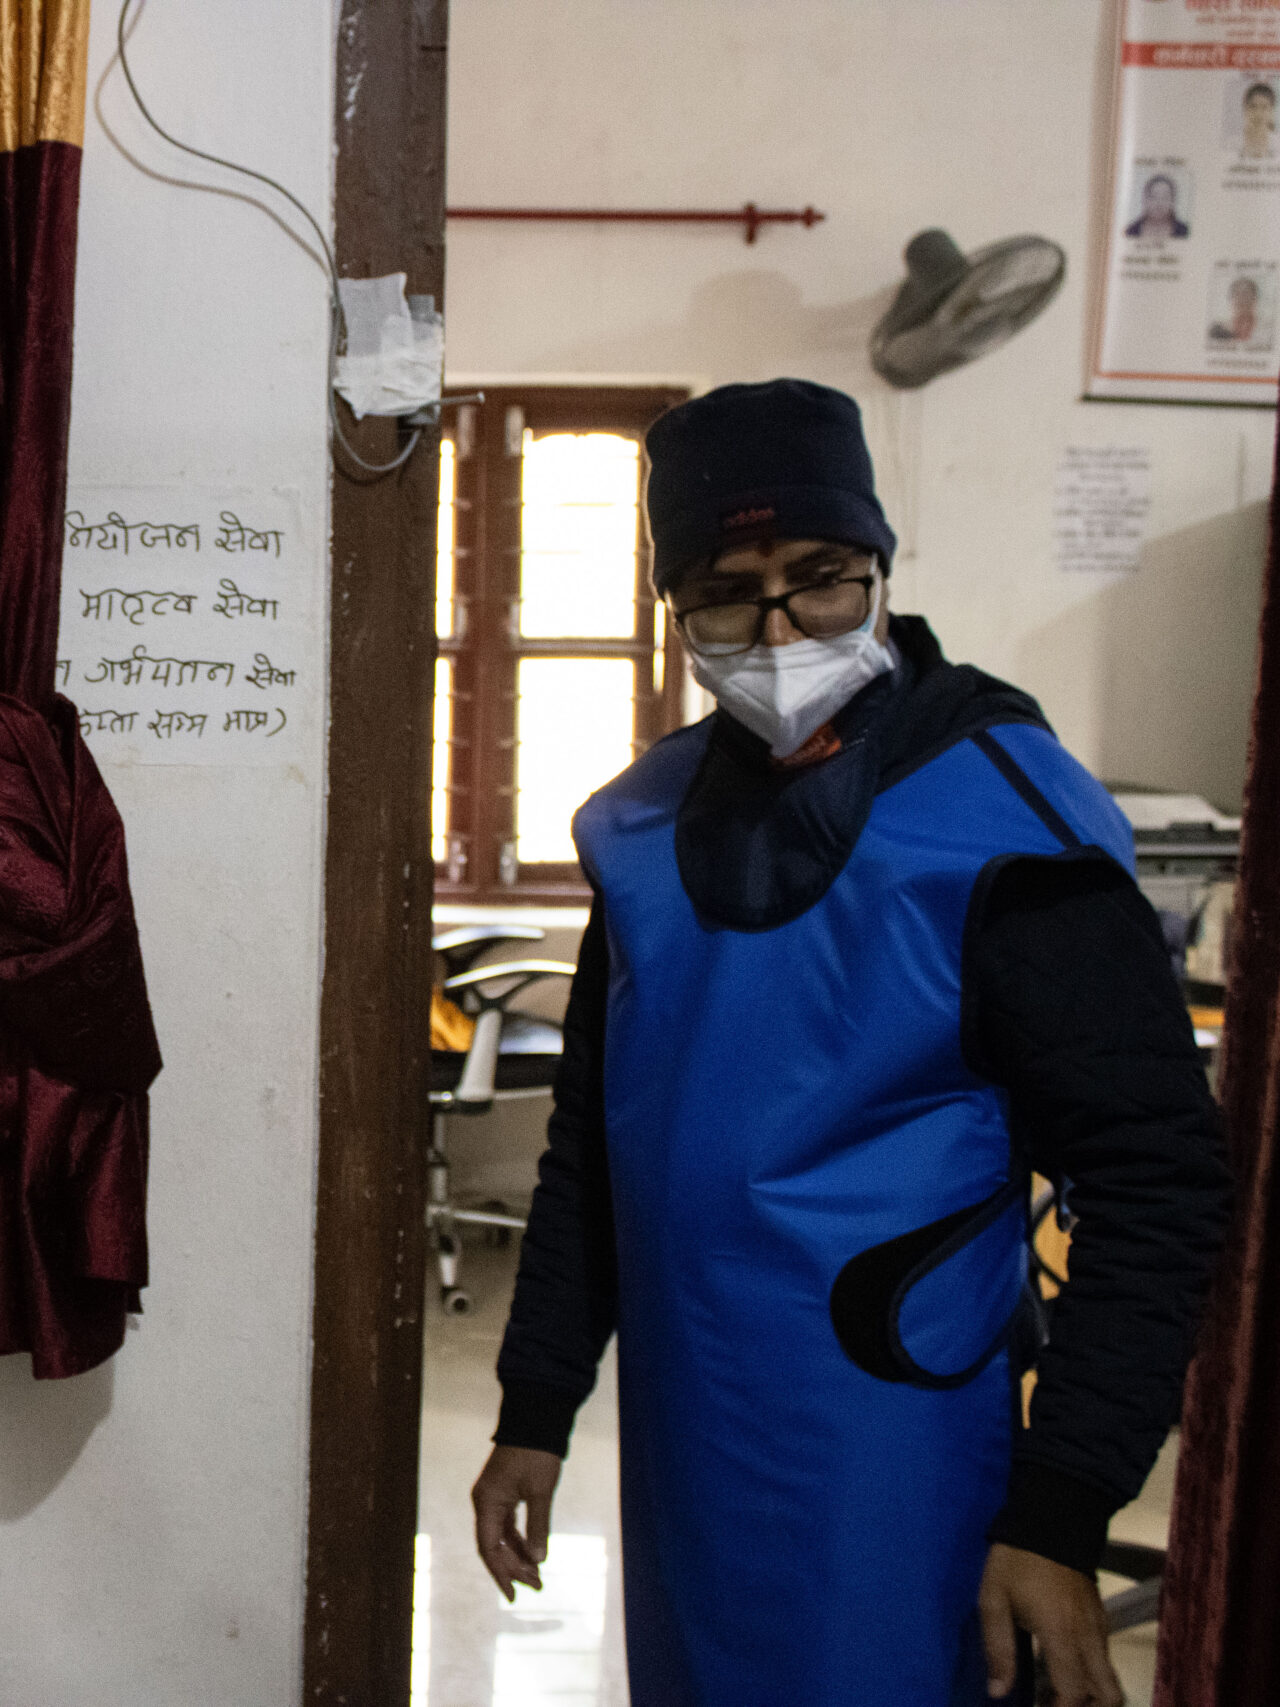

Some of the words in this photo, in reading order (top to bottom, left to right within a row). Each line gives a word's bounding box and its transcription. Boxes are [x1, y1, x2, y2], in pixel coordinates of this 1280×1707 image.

[214, 510, 285, 558] सेवा
[212, 577, 280, 620] सेवा
[244, 652, 297, 689] सेवा
